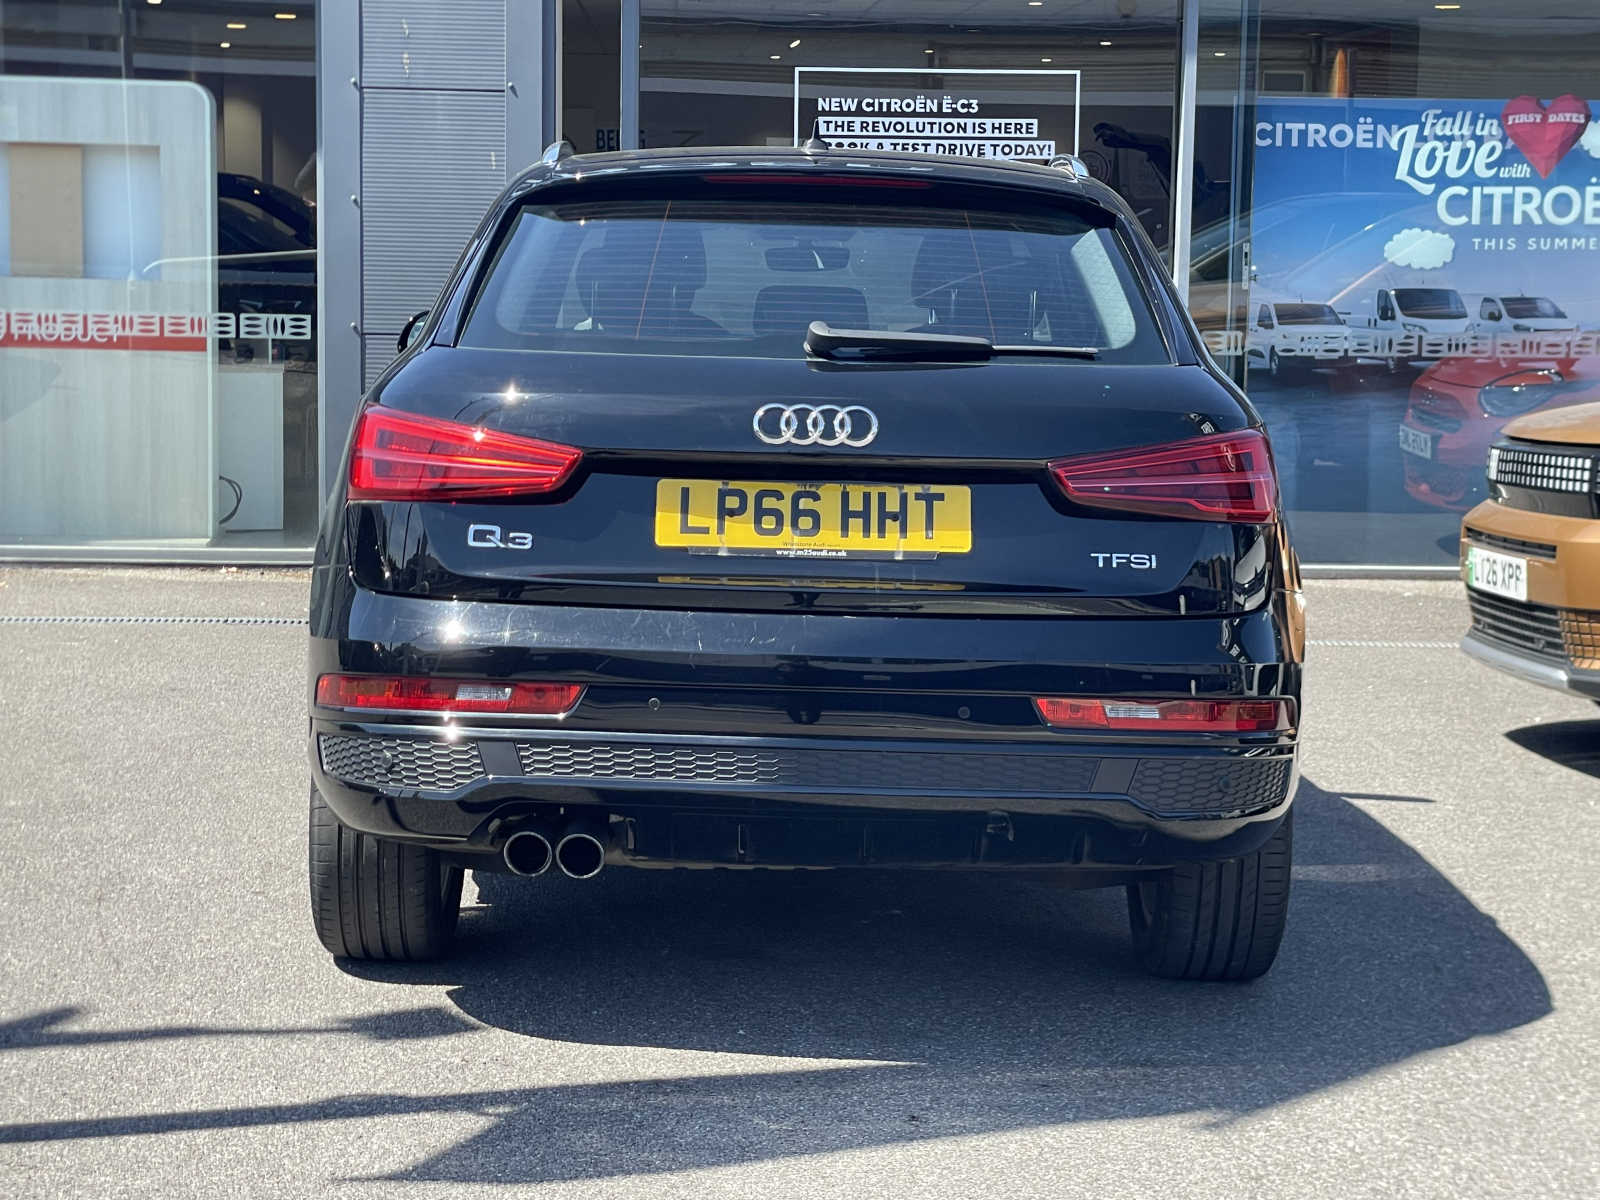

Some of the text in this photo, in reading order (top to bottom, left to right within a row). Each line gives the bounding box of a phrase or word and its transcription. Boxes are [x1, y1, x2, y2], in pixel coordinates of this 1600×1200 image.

[818, 95, 979, 113] NEW CITROËN Ë-C3
[823, 121, 1034, 134] THE REVOLUTION IS HERE
[1421, 109, 1499, 136] Fall in
[1507, 112, 1586, 125] FIRST DATES
[1255, 117, 1400, 148] CITROËN
[890, 142, 931, 152] TEST
[935, 143, 986, 157] DRIVE
[990, 144, 1052, 156] TODAY!
[1389, 124, 1503, 196] Love
[1499, 163, 1531, 178] with
[1437, 176, 1600, 227] CITROË
[1472, 237, 1598, 250] THIS SUMME
[679, 486, 945, 540] LP66 HHT
[467, 524, 533, 549] Q3
[776, 549, 847, 557] www.m25audi.co.uk
[1090, 553, 1157, 569] TFSI
